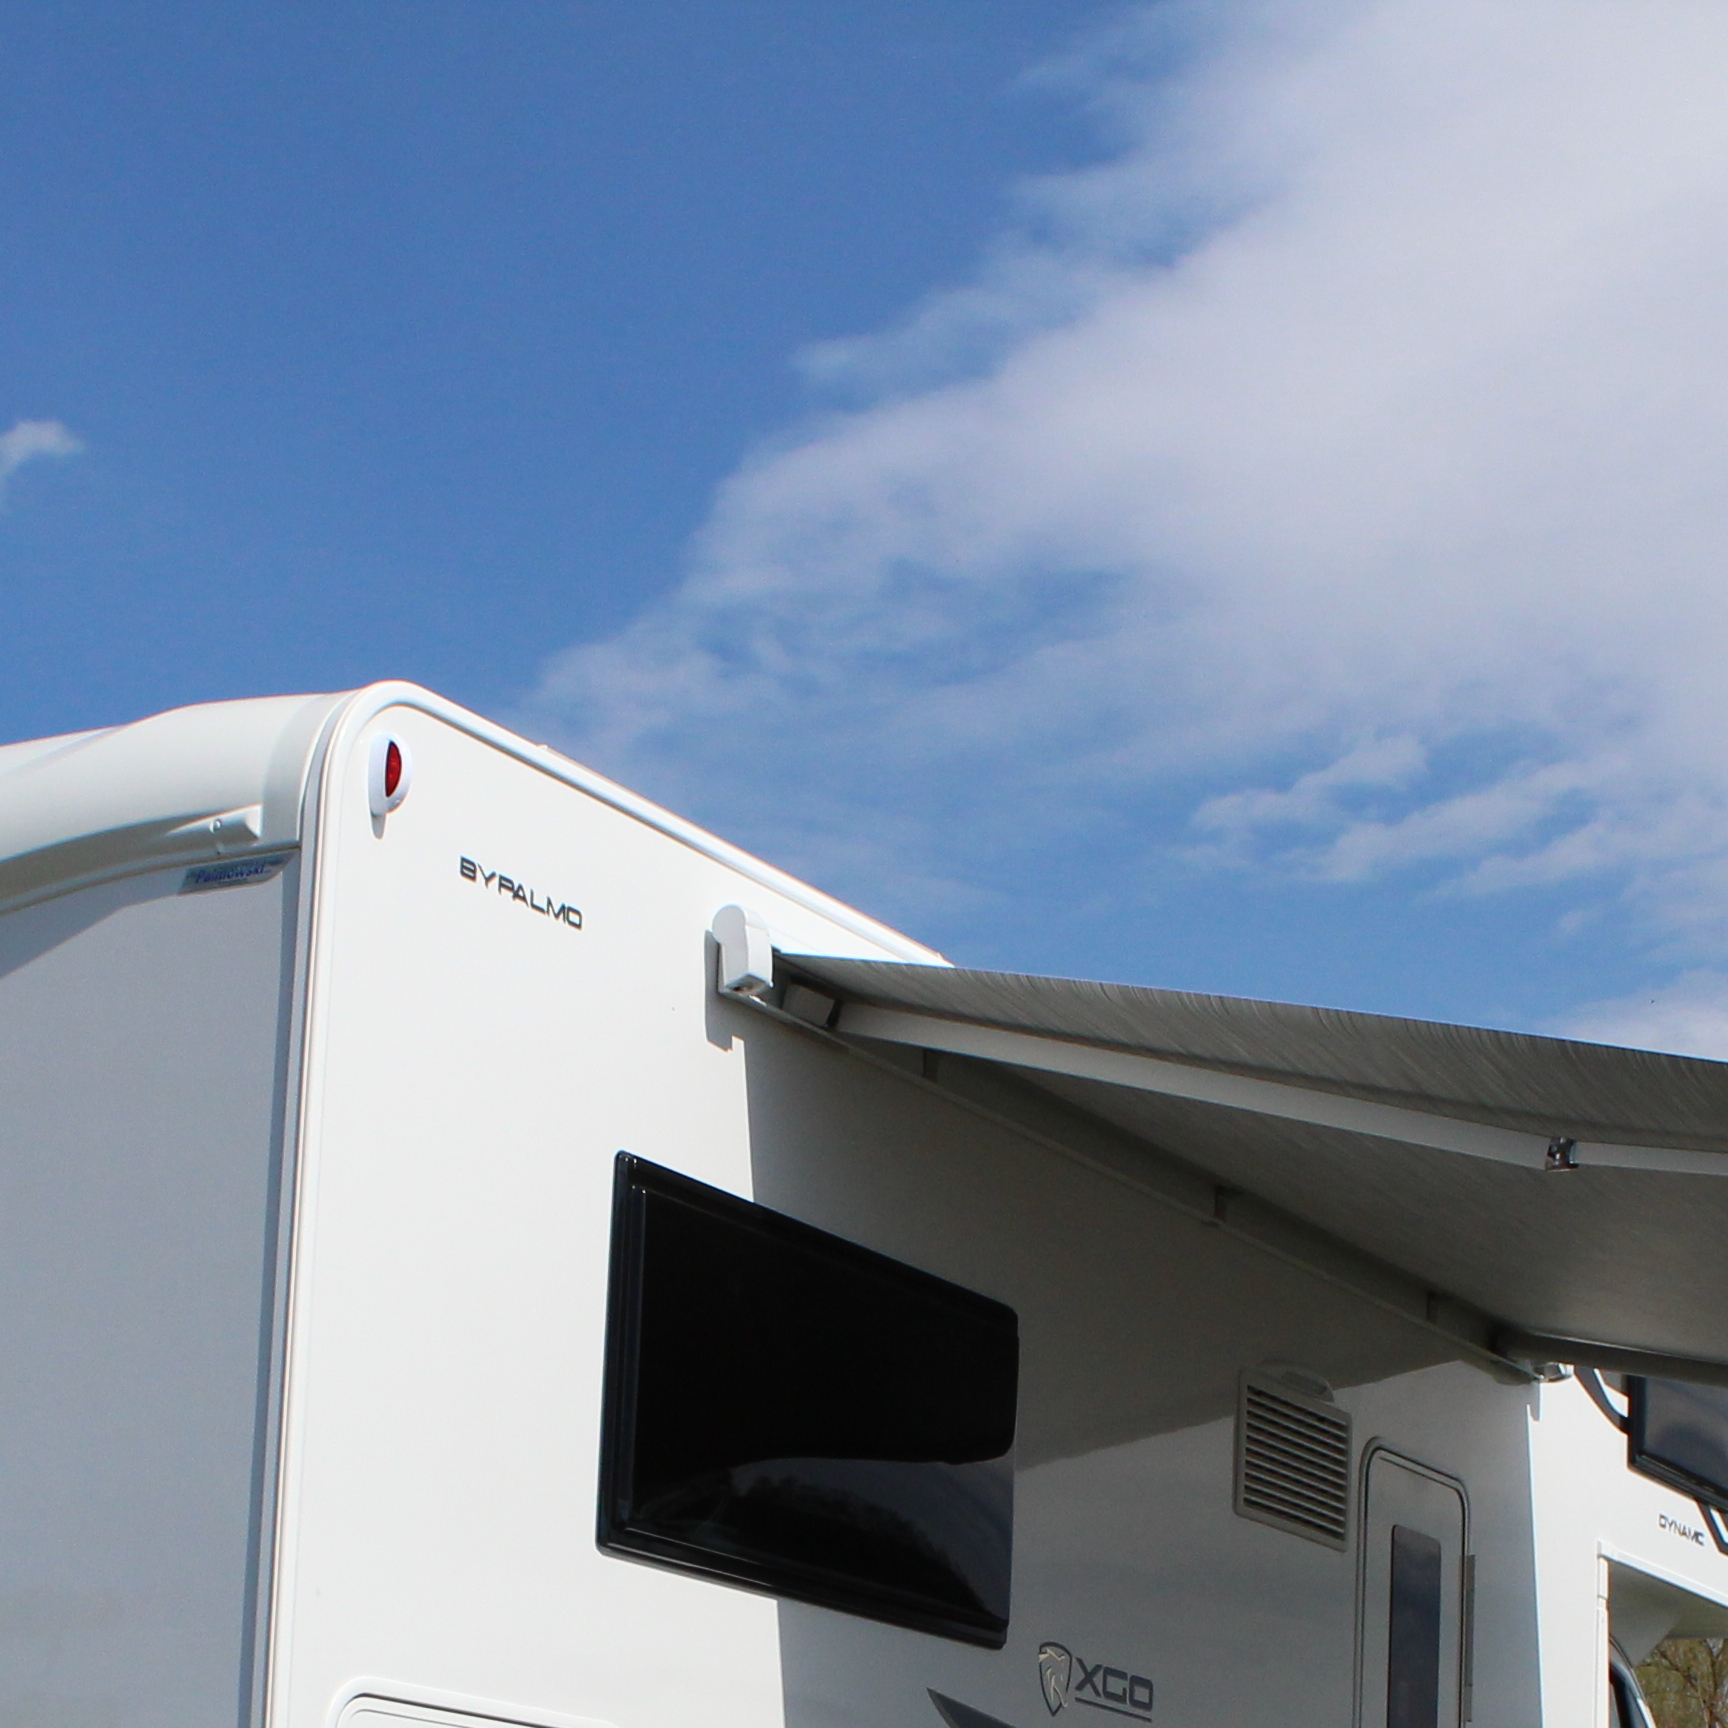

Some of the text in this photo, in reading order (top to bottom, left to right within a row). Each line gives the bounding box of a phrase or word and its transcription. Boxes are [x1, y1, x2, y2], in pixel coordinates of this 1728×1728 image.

[459, 855, 583, 931] BYPALMO
[1658, 1513, 1705, 1546] DYNAMIC
[1074, 1656, 1154, 1711] XGO
